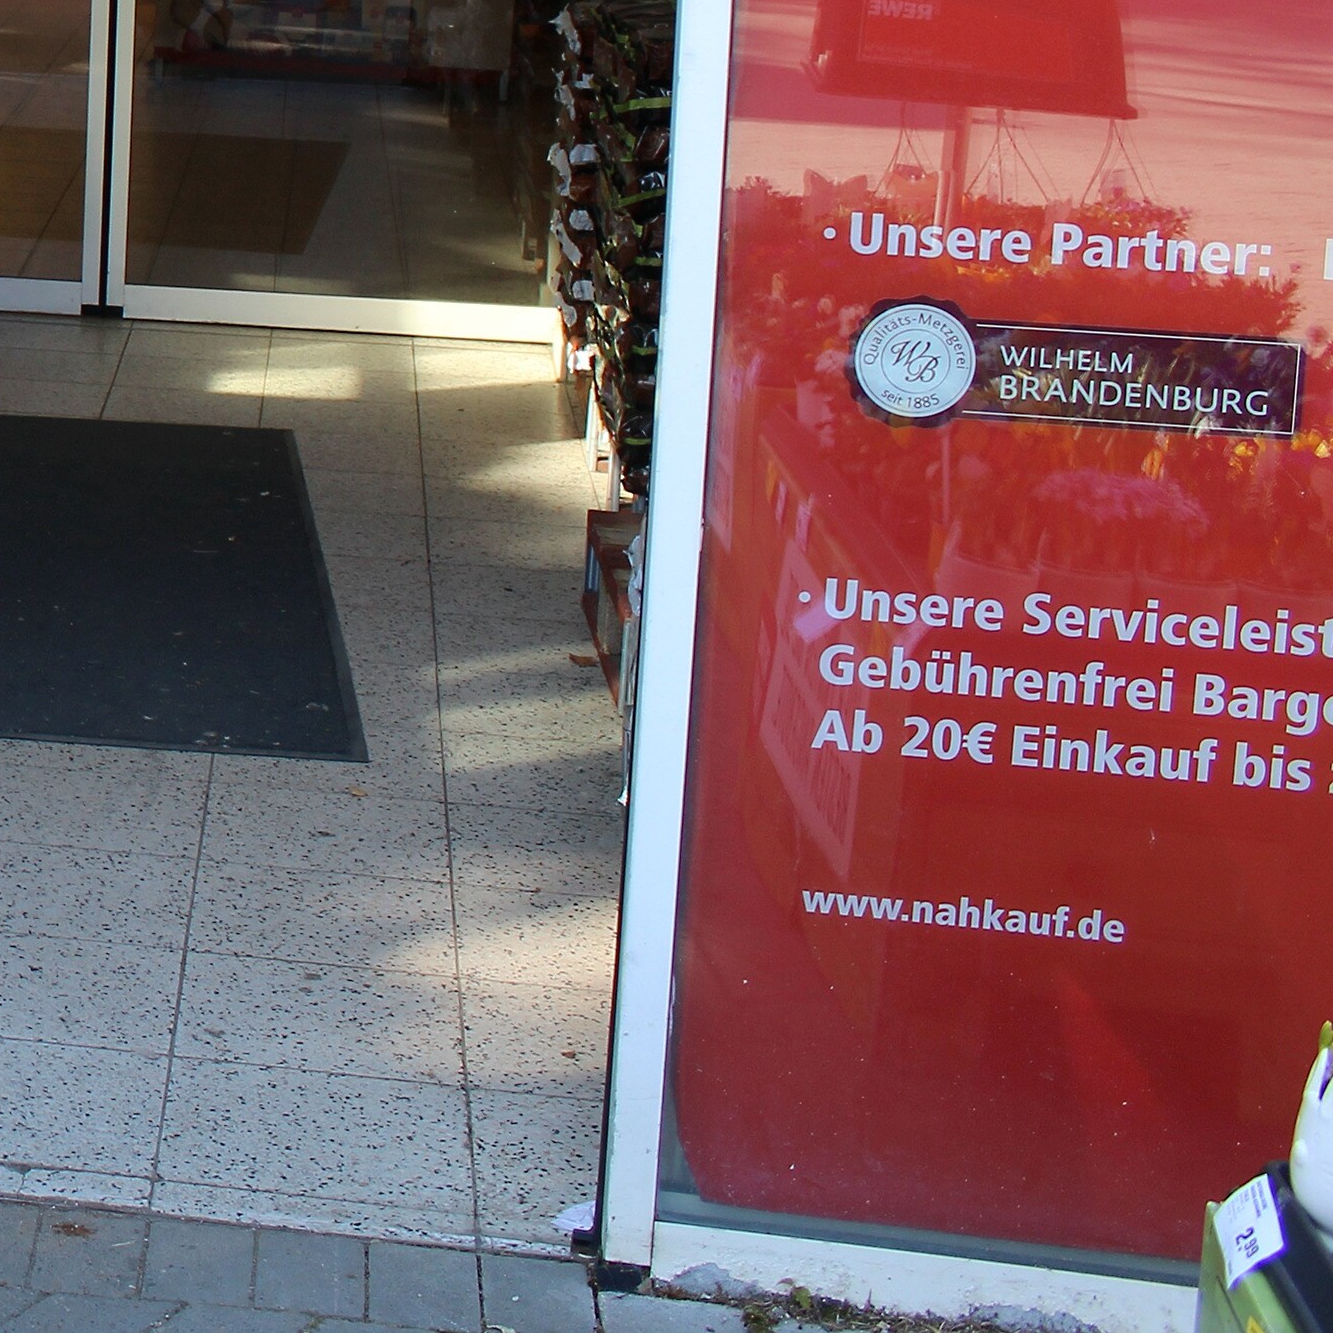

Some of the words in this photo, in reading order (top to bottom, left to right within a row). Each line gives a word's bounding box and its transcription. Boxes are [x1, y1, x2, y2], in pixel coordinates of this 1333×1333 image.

[849, 211, 1032, 263] Unsere
[1051, 223, 1272, 277] Partner:
[864, 313, 968, 371] Qualitäts-Metzgerei
[999, 345, 1134, 374] WILHELM
[880, 386, 904, 406] seit
[907, 391, 941, 409] 1885
[999, 375, 1268, 417] BRANDENBURG
[824, 576, 1004, 632] Unsere
[818, 642, 1174, 713] Gebührenfrei
[811, 709, 882, 753] Ab
[901, 716, 997, 764] 20€
[1011, 724, 1218, 783] Einkauf
[1232, 741, 1311, 792] bis
[802, 888, 1125, 943] www.nahkauf.de
